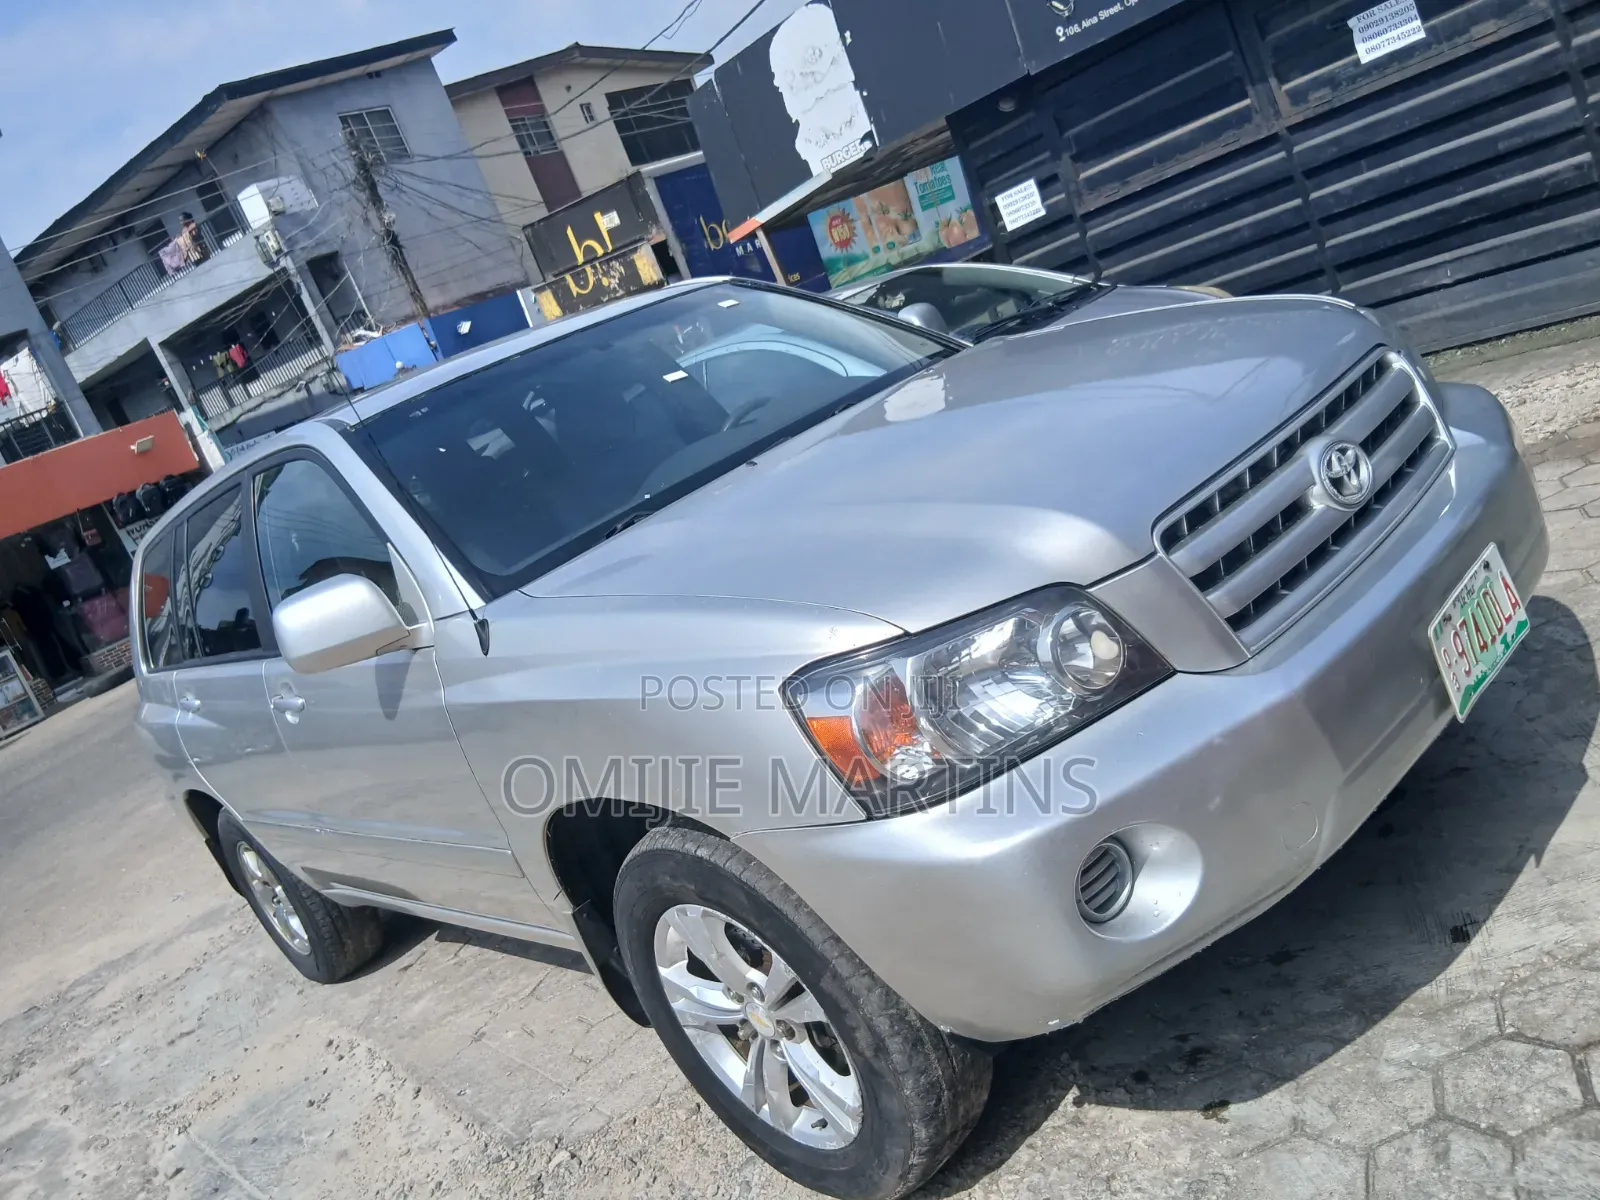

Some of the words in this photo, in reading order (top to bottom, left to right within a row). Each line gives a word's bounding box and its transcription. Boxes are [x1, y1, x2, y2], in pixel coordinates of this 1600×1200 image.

[1065, 24, 1082, 37] 106,
[1081, 15, 1099, 30] Aina
[1098, 2, 1125, 21] Street,
[1356, 9, 1376, 24] FOR
[1358, 3, 1416, 34] 09029138205
[913, 174, 953, 195] Tomatoes
